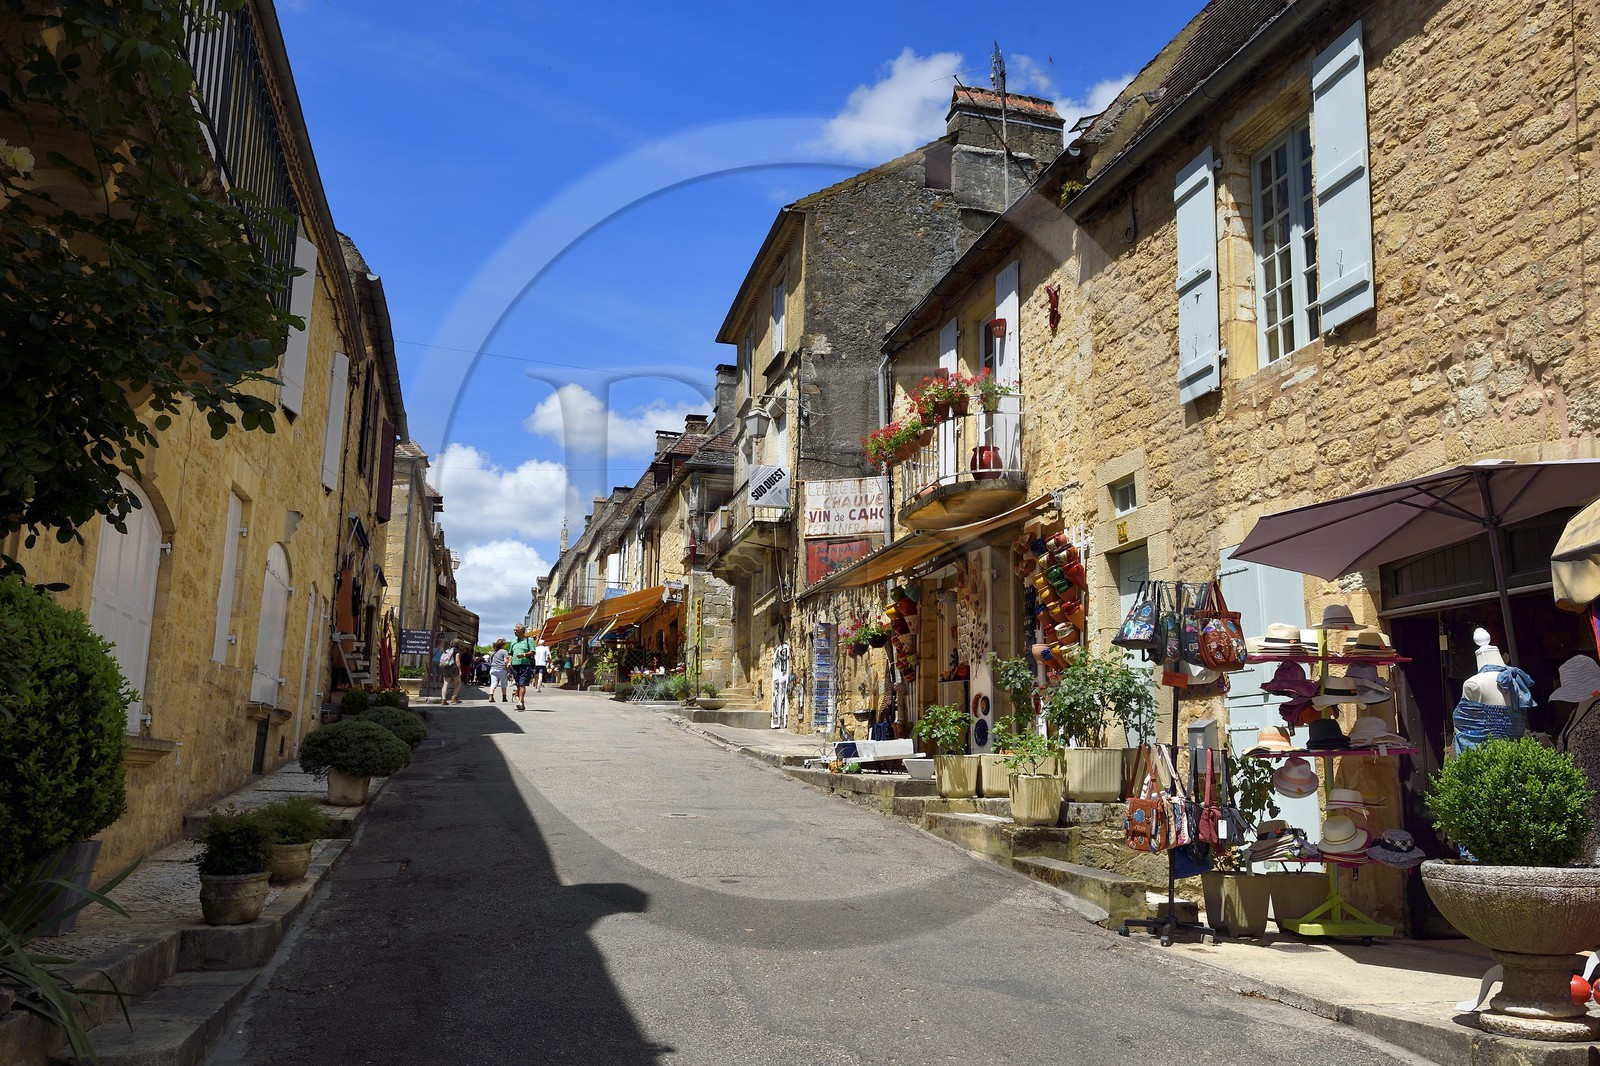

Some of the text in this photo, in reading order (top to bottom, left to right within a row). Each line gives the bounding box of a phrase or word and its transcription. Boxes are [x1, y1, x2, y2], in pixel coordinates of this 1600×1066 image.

[751, 484, 767, 501] SUD
[763, 468, 786, 490] OUEST
[809, 510, 831, 523] VIN
[834, 512, 845, 522] de
